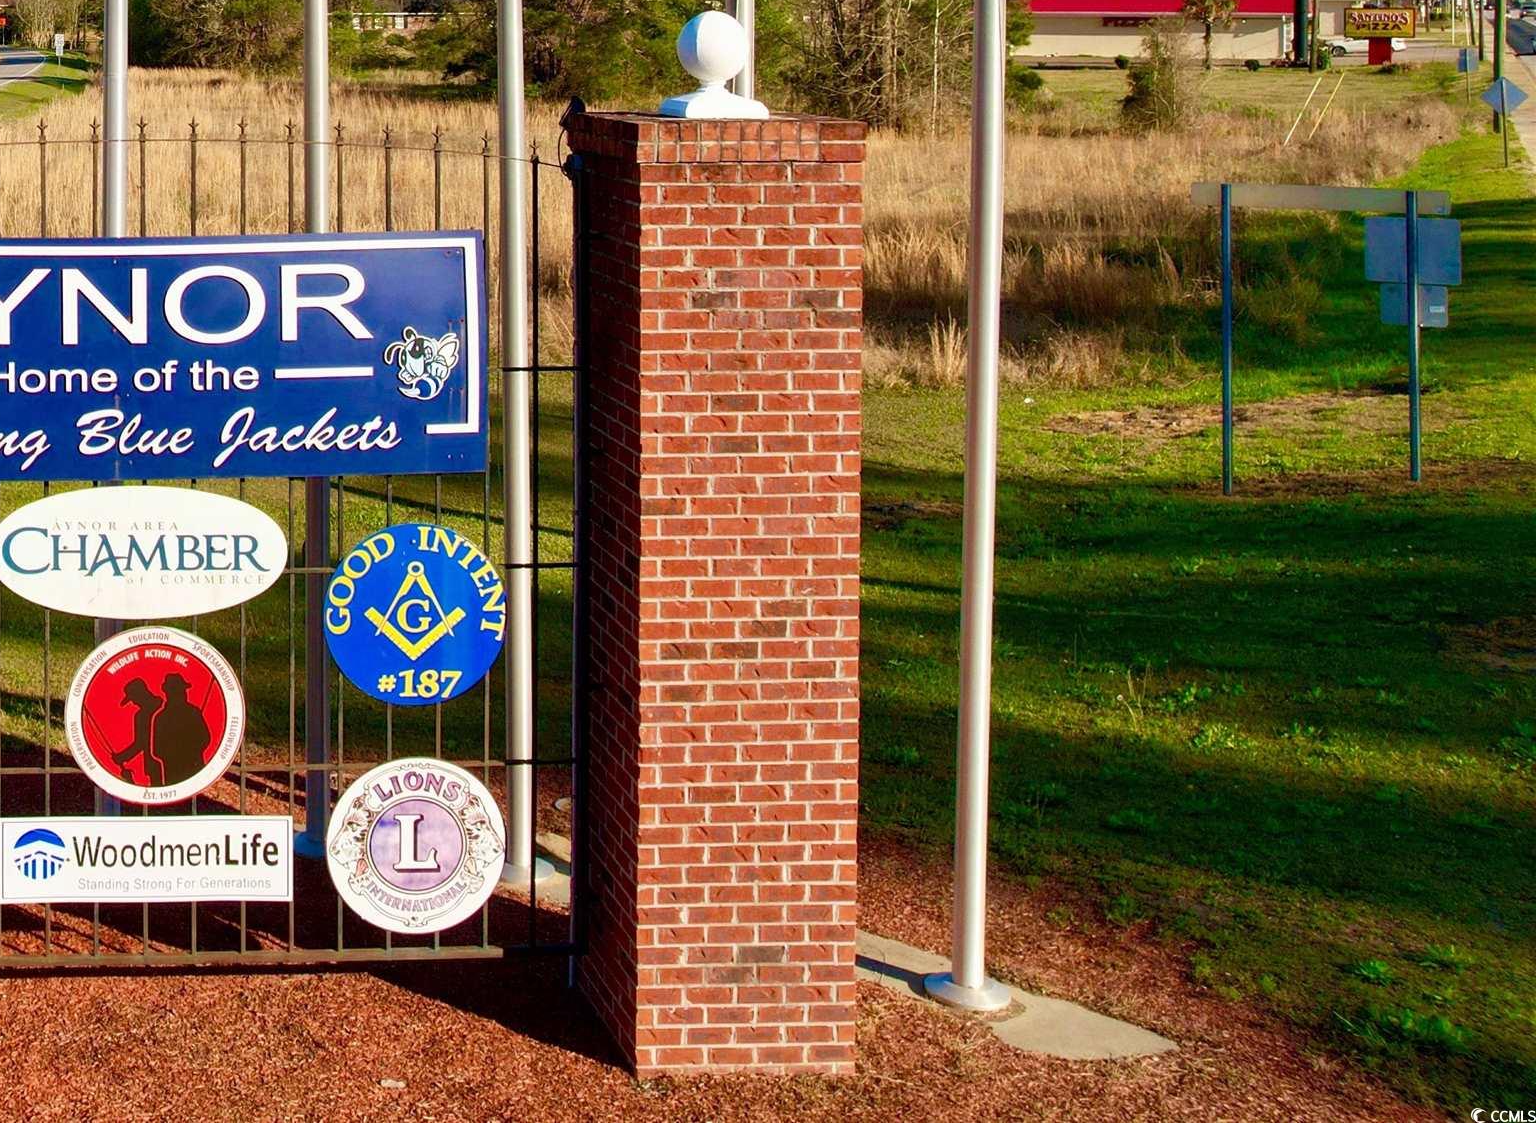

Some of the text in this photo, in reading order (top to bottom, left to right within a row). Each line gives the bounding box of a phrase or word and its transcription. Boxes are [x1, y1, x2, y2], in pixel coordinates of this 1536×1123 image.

[133, 360, 180, 392] of
[186, 359, 260, 391] the
[76, 409, 194, 454] Blue
[212, 406, 403, 468] Jackets
[52, 521, 179, 531] AYNOR AREA
[1, 526, 270, 577] CHAMBER
[160, 575, 265, 585] COMMERCE
[326, 526, 506, 641] GOOD INTENT
[396, 599, 432, 633] G
[128, 632, 170, 644] EDUCATION
[107, 651, 140, 676] WILDLIFE
[144, 649, 172, 660] ACTION
[192, 642, 235, 692] SPORTSMANSHIP
[377, 669, 462, 698] #187
[372, 771, 462, 802] LIONS
[72, 833, 279, 868] WoodmenLife
[393, 813, 441, 873] L
[77, 876, 272, 893] Standing Strong For Generations
[366, 880, 468, 912] INTERNATIONAL
